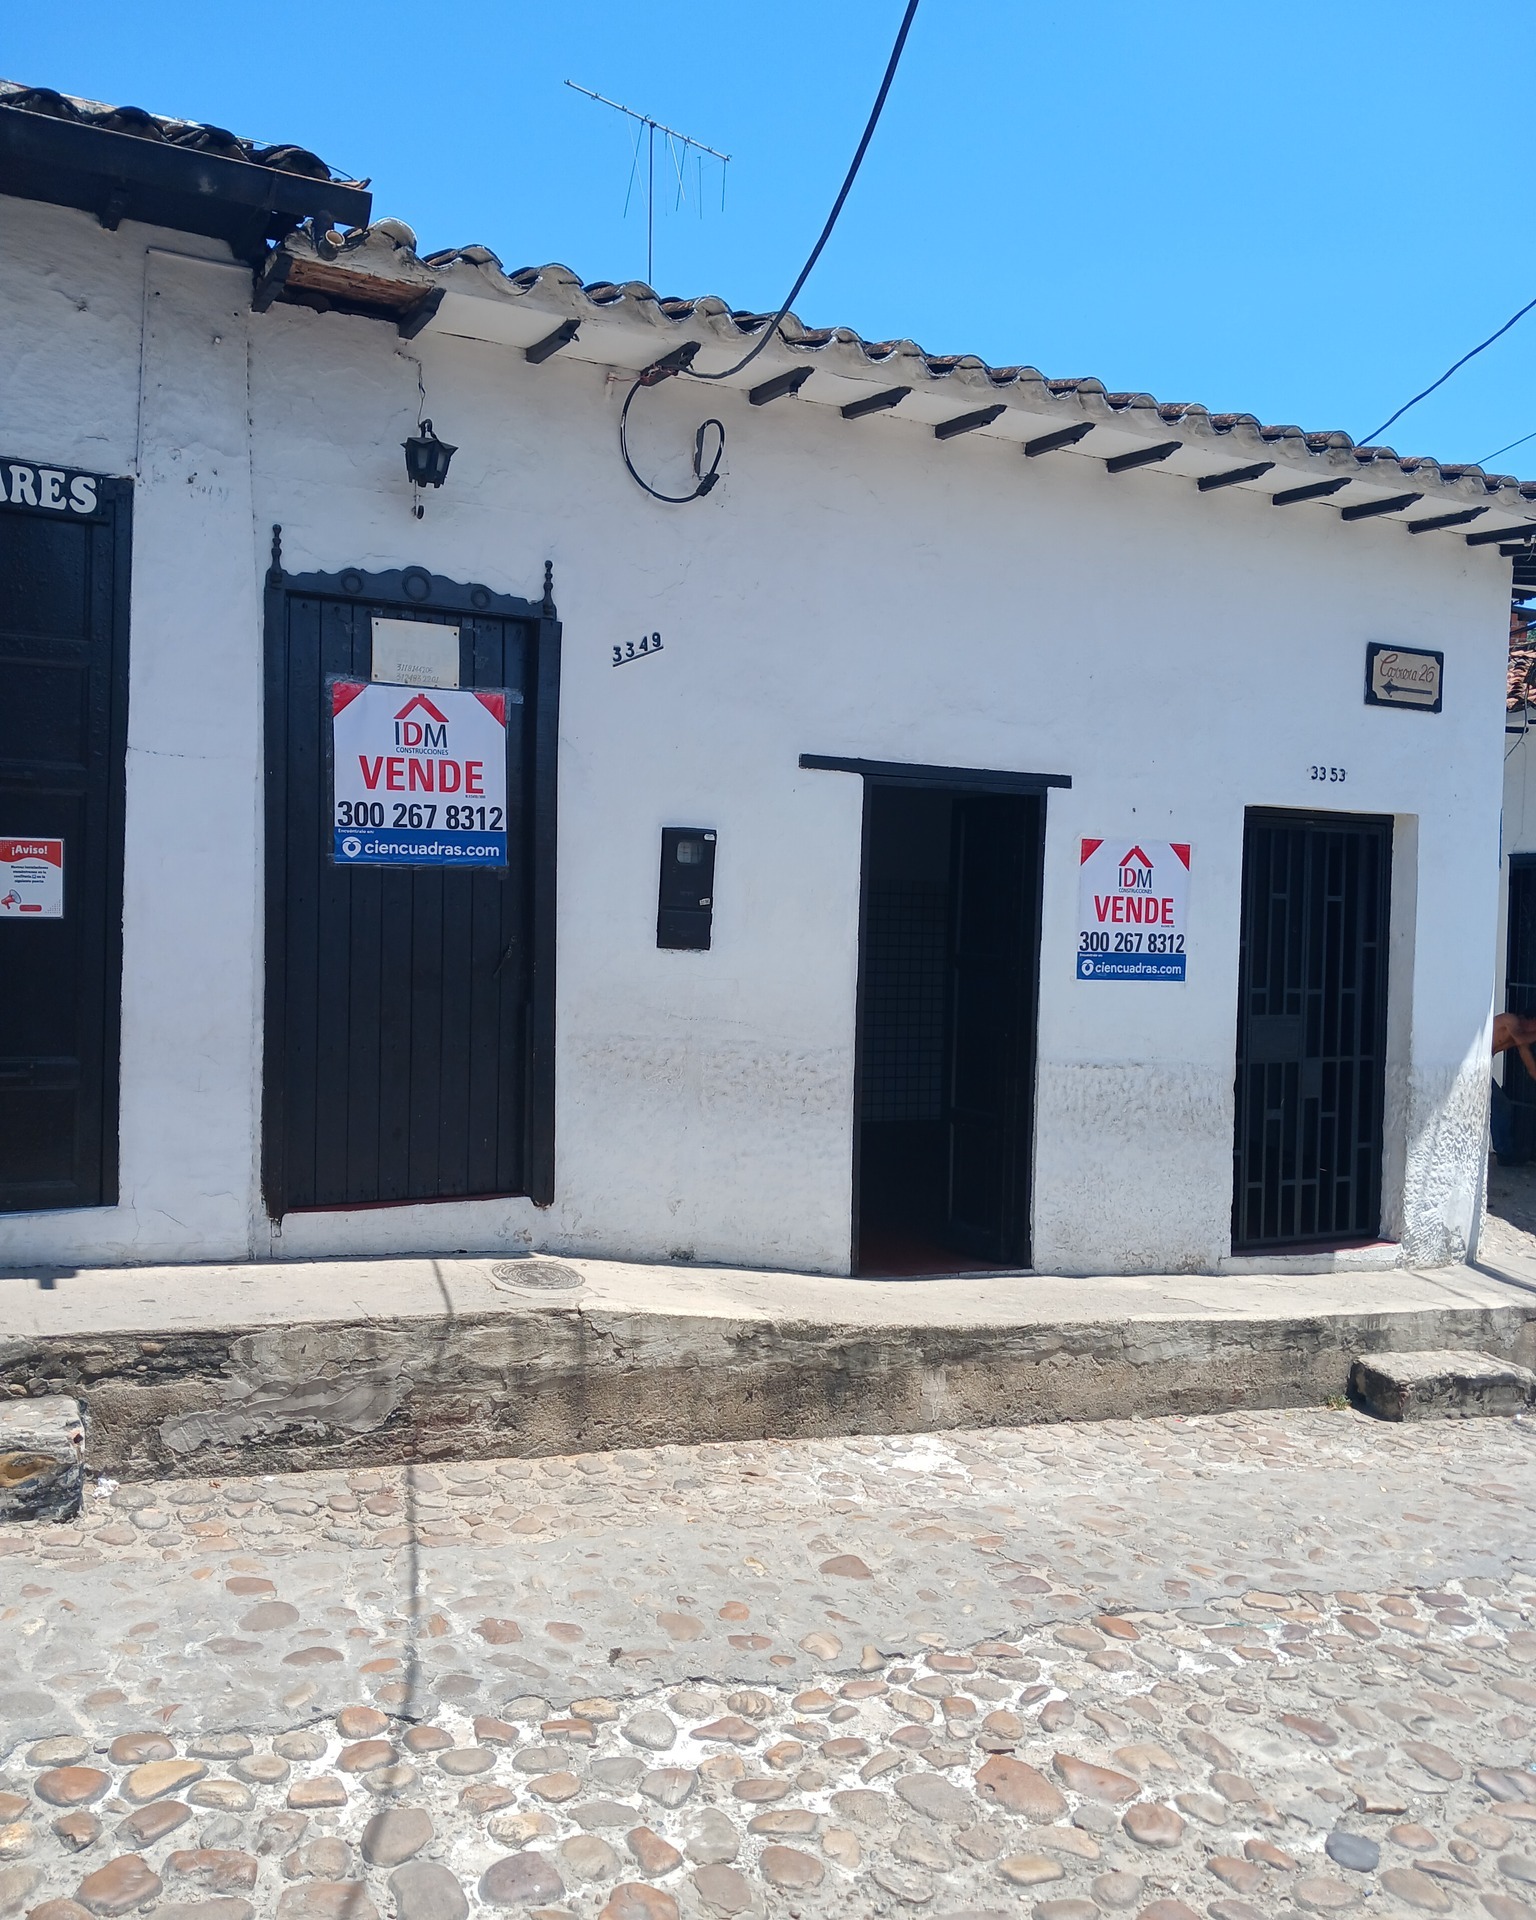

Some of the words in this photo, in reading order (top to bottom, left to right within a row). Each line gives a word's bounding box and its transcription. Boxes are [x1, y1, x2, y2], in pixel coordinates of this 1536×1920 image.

[0, 464, 98, 514] RES
[612, 631, 662, 663] 3349
[1380, 653, 1418, 681] Carrera
[1418, 663, 1436, 683] 26
[394, 721, 448, 748] IDM
[395, 747, 449, 756] CONSTRUCCIONES
[358, 755, 484, 794] VENDE
[337, 801, 385, 828] 300
[392, 803, 437, 829] 267
[446, 805, 504, 831] 8312
[11, 844, 48, 856] ¡Aviso!
[364, 839, 500, 857] ciencuadras.com
[1118, 867, 1152, 888] IDM
[1094, 895, 1174, 925] VENDE
[1079, 931, 1110, 952] 300
[1114, 932, 1143, 953] 267
[1147, 933, 1185, 954] 8312
[1094, 961, 1182, 976] ciencuadras.com
